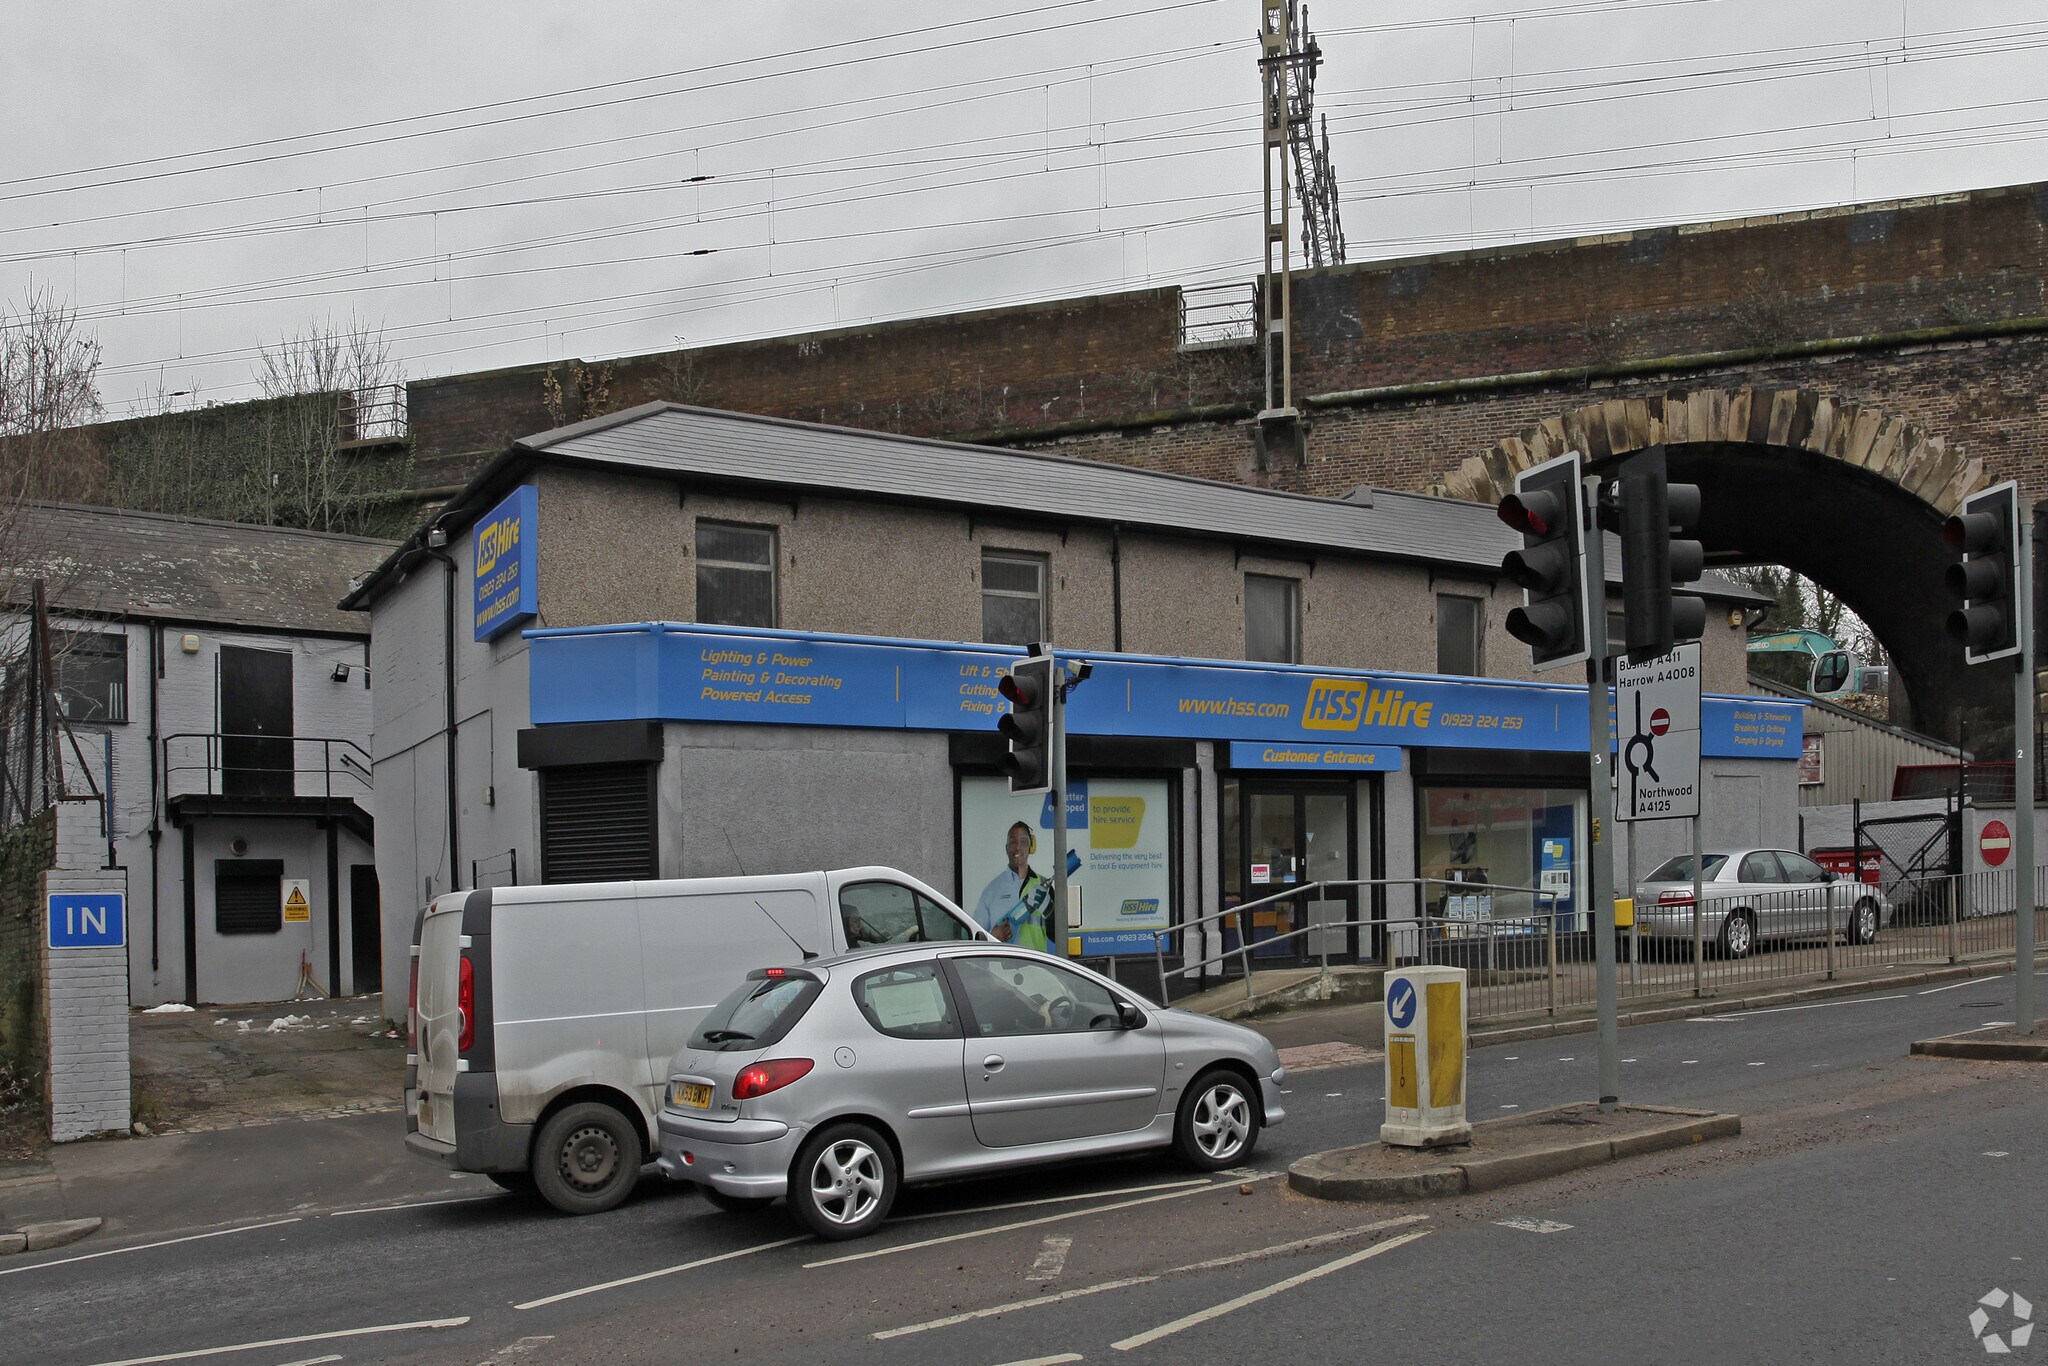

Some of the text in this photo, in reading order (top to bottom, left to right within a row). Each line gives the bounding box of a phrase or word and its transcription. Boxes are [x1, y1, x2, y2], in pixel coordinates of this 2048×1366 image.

[478, 516, 520, 573] HSS Hire
[478, 560, 519, 602] 01923 224 253
[476, 586, 520, 628] www.hss.com
[701, 649, 813, 667] Lighting & Power
[1620, 659, 1653, 671] Buey
[960, 664, 978, 676] Lift
[982, 665, 992, 676] &
[1619, 666, 1695, 688] Harrow A4008
[702, 669, 842, 690] Painting & Decorating
[701, 687, 812, 704] Powered Access
[960, 684, 999, 698] Cutting
[960, 700, 1006, 714] Fixing &
[1178, 685, 1524, 730] www.hss.com HSS Hire 01923 224 253
[1262, 748, 1375, 765] Customer Entrance
[1594, 753, 1602, 764] 3
[2017, 749, 2023, 758] 2
[1065, 792, 1084, 802] etter
[1640, 784, 1692, 799] Northwood
[1093, 805, 1131, 814] to provide
[1640, 801, 1671, 813] A4125
[1093, 816, 1136, 824] hire service
[1090, 854, 1121, 862] Delivering
[1118, 862, 1150, 870] equipment
[1123, 902, 1158, 912] HSS Hire
[66, 907, 106, 934] IN
[1116, 934, 1136, 942] 01923
